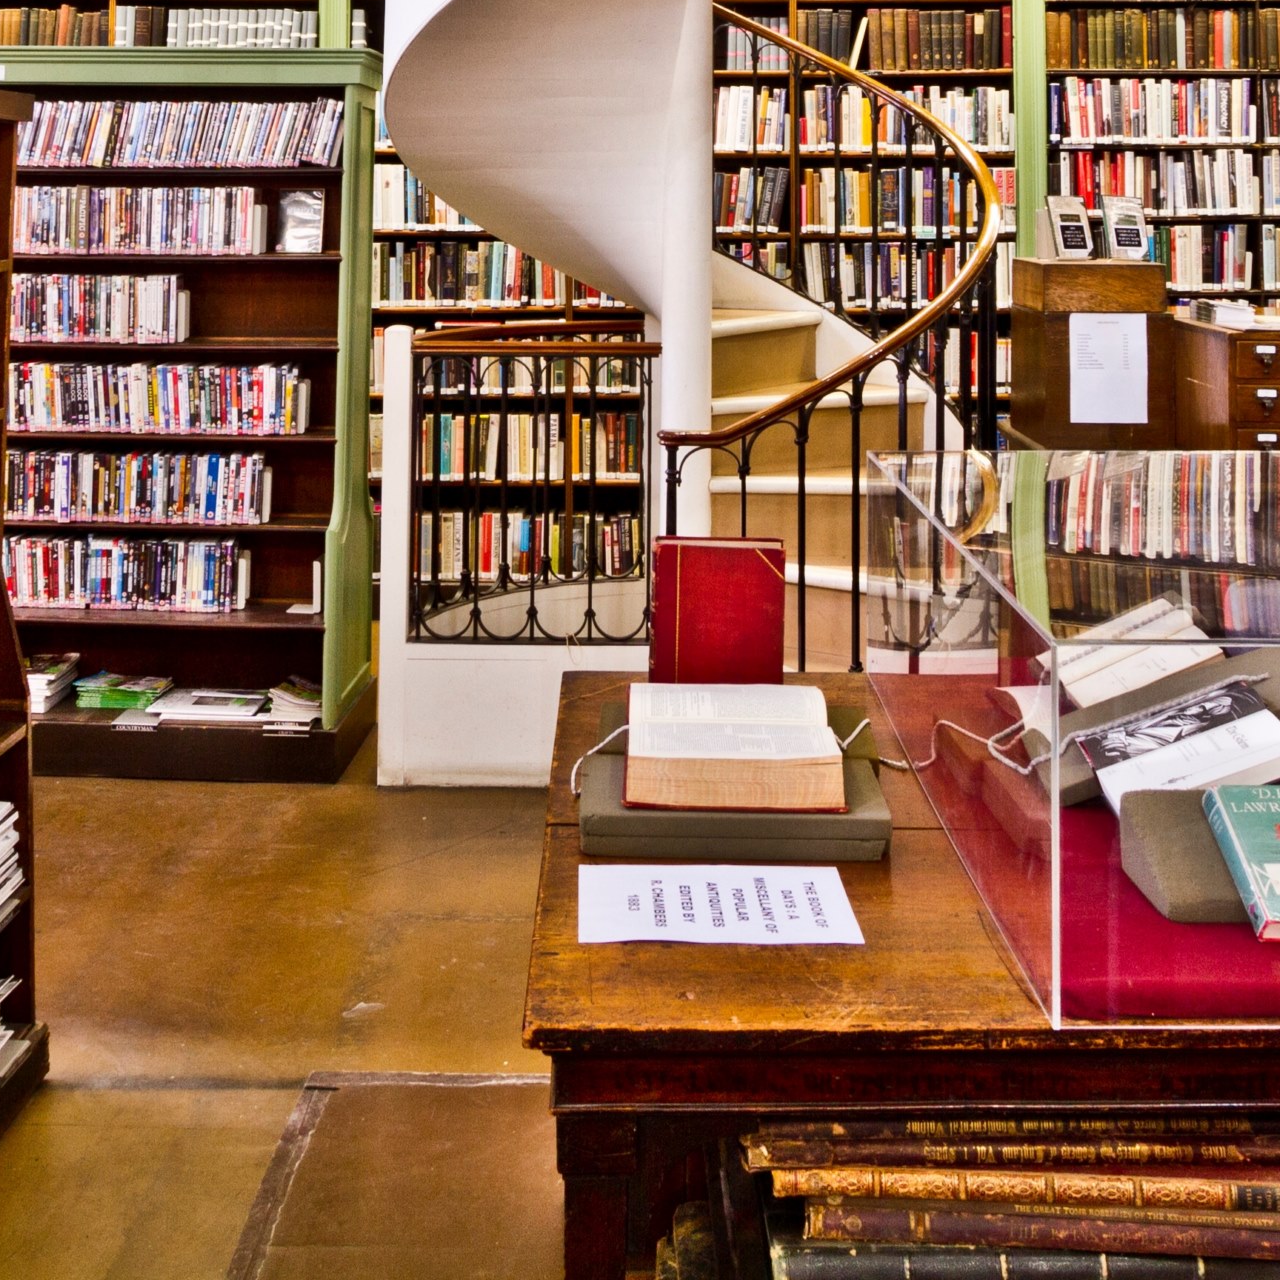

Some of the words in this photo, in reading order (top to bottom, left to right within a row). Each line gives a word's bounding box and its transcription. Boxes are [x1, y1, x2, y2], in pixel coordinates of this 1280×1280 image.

[1220, 89, 1230, 129] DEMOCRACY
[79, 199, 87, 231] PACIFIC
[550, 418, 558, 448] PAXMAN
[679, 885, 694, 911] EDITED
[781, 890, 794, 909] DAYS
[802, 881, 816, 895] THE
[627, 894, 640, 911] 1883
[652, 887, 668, 928] CHAMBERS
[705, 882, 725, 928] ANTIQUITIES
[731, 888, 750, 921] POPULAR
[752, 877, 774, 922] MISCELLANY
[765, 924, 779, 934] OF
[807, 897, 825, 918] BOOK
[682, 913, 696, 923] BY
[815, 919, 829, 928] OF
[972, 1145, 995, 1163] Vol.
[1014, 1204, 1030, 1214] THE
[1033, 1205, 1061, 1215] GREAT
[1063, 1206, 1086, 1216] TOMB
[1134, 1210, 1146, 1218] OF
[1147, 1212, 1165, 1220] THE
[1190, 1214, 1232, 1224] EGYPTIAN
[1235, 1216, 1274, 1227] DYNASTY
